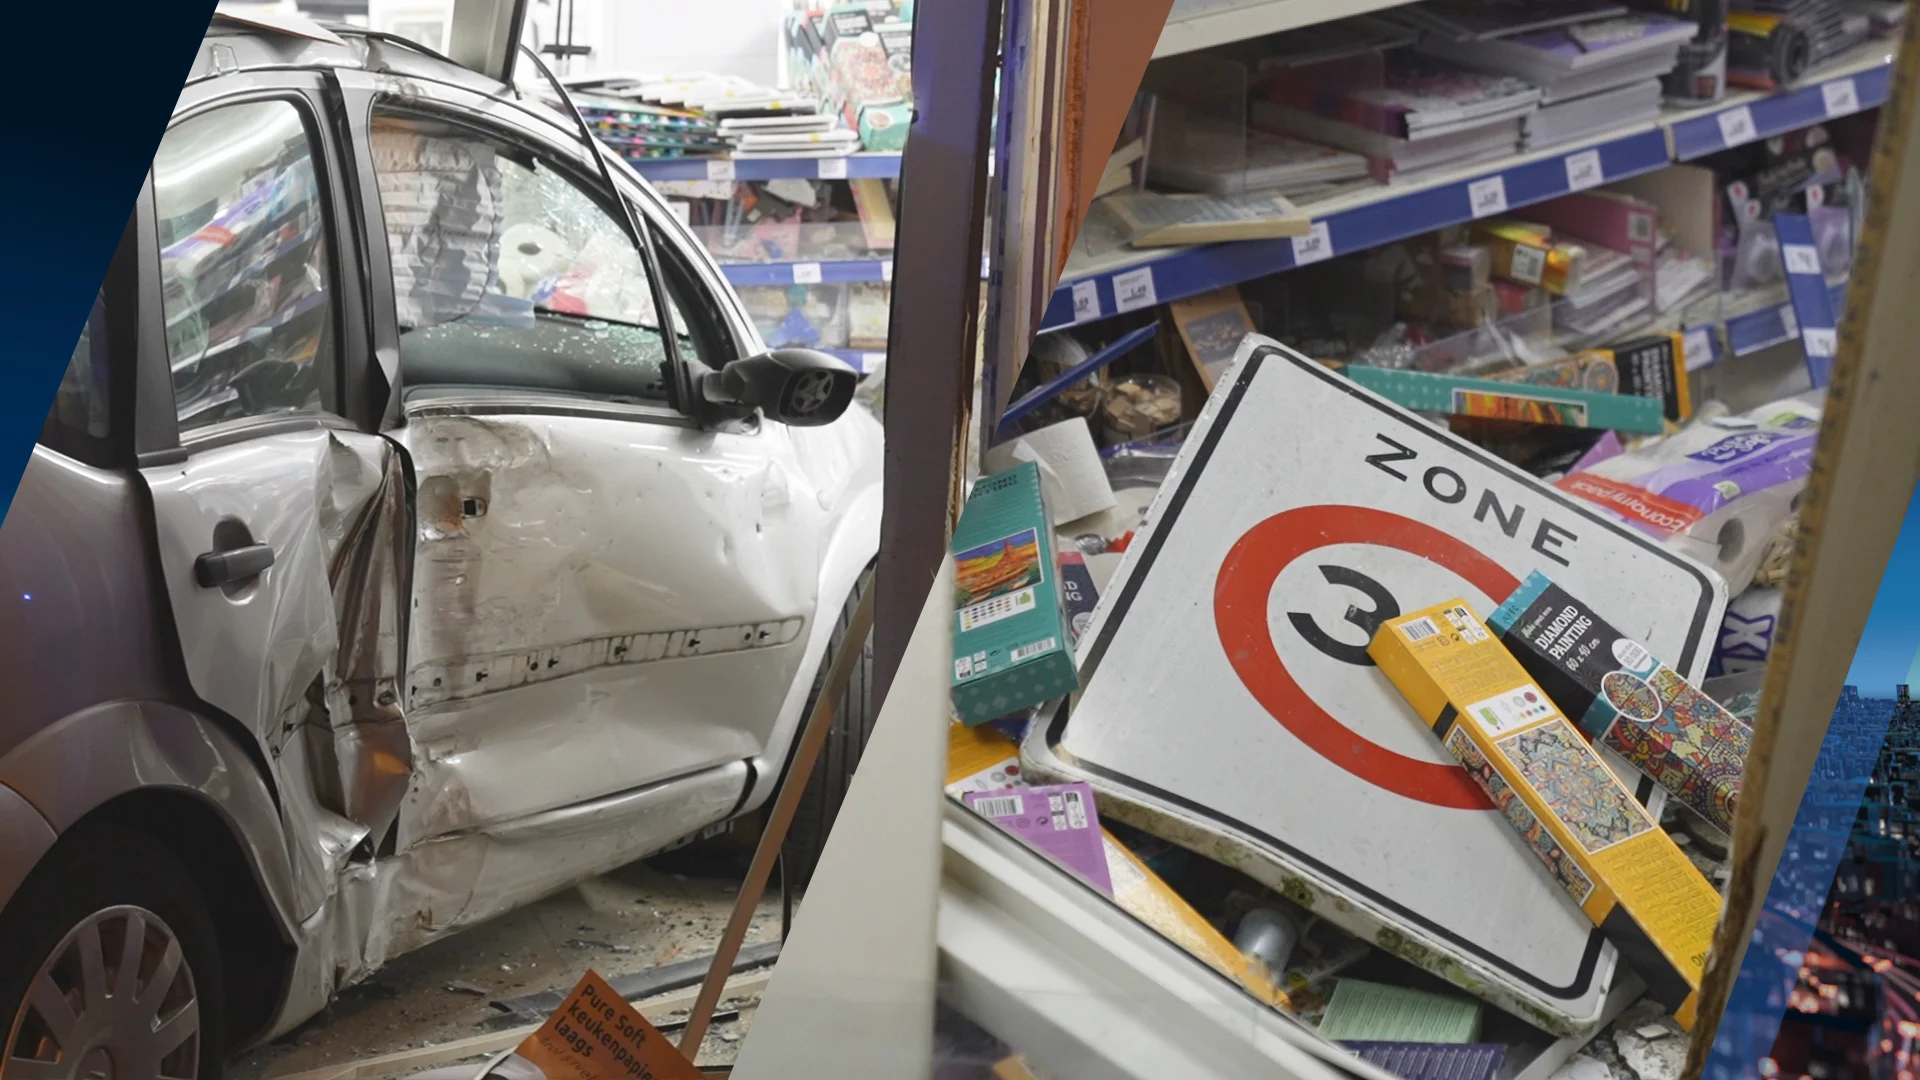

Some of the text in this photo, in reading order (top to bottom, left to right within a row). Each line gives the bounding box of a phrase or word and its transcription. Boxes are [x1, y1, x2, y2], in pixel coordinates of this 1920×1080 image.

[1364, 432, 1578, 568] ZONE
[1609, 489, 1686, 534] Economy
[1534, 605, 1579, 650] DIAMOND
[1548, 615, 1593, 660] PAINTING
[1565, 658, 1579, 672] 60
[1579, 644, 1592, 657] 40
[1589, 638, 1601, 651] cm
[555, 1016, 595, 1058] laags
[581, 983, 647, 1050] Pure Soft
